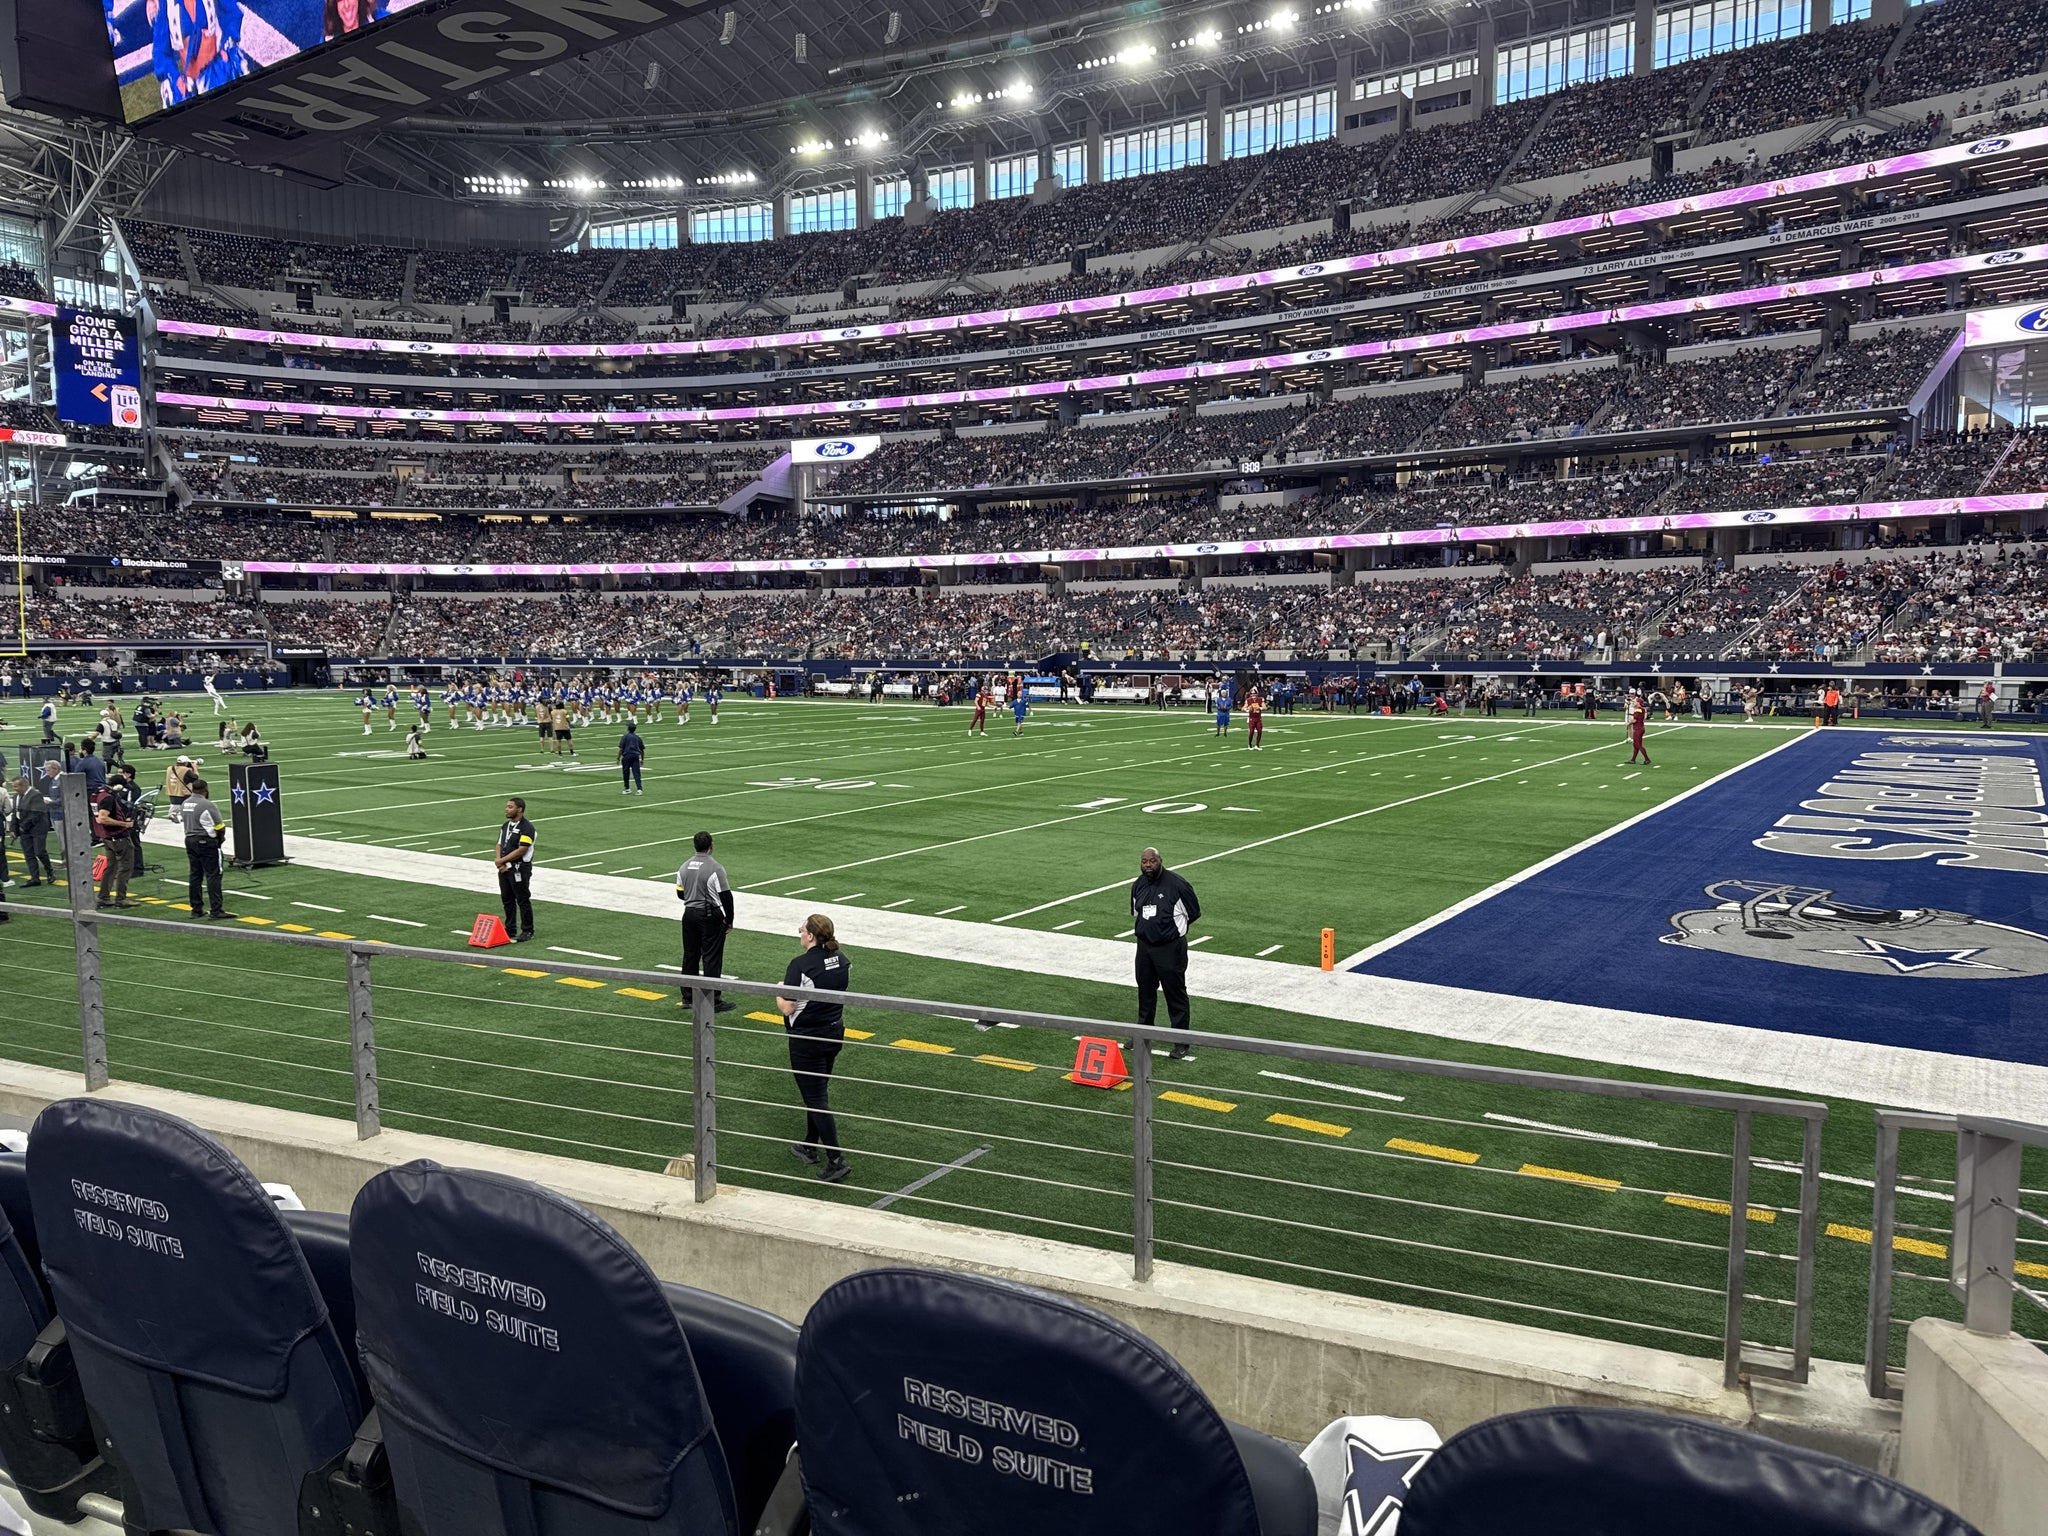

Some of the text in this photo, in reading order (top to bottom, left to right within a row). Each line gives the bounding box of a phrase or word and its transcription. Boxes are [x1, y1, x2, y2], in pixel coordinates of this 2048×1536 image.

[236, 0, 708, 131] NSTAR
[1976, 140, 2006, 155] Ford
[1769, 235, 1781, 244] 94
[1843, 219, 1874, 232] WARE
[1879, 217, 1896, 225] 2005
[1902, 212, 1920, 220] 2013
[1582, 267, 1594, 275] 73
[1596, 261, 1626, 272] LARRY
[1627, 256, 1657, 267] ALLEN
[1989, 252, 2018, 266] Ford
[1433, 287, 1463, 297] EMMITT
[1464, 283, 1489, 292] SMITH
[1284, 312, 1302, 320] TROY
[1302, 307, 1330, 317] AIKMAN
[75, 315, 117, 329] COME
[69, 324, 124, 341] GRAB A
[1149, 330, 1177, 338] MICHAEL
[69, 335, 126, 351] MILLER
[1016, 346, 1044, 355] CHARLES
[1044, 343, 1065, 352] HALEY
[81, 347, 115, 360] LITE
[911, 358, 941, 366] WOODSON
[74, 364, 122, 375] MILLER LITE
[81, 370, 117, 379] LANDING
[769, 371, 786, 379] JIMMY
[786, 369, 812, 377] JOHNSON
[117, 394, 139, 407] Lite
[821, 442, 850, 456] Ford
[1241, 461, 1261, 474] 13:08
[1747, 512, 1773, 523] Ford
[122, 558, 188, 569] Blockchain.com
[1080, 1043, 1108, 1081] G
[71, 1178, 169, 1223] RESERVED
[73, 1208, 185, 1259] FIELD SUITE
[417, 1251, 547, 1312] RESERVED
[415, 1282, 560, 1352] FIELD SUITE
[904, 1377, 1080, 1448] RESERVED
[897, 1413, 1094, 1495] FIELD SUITE
